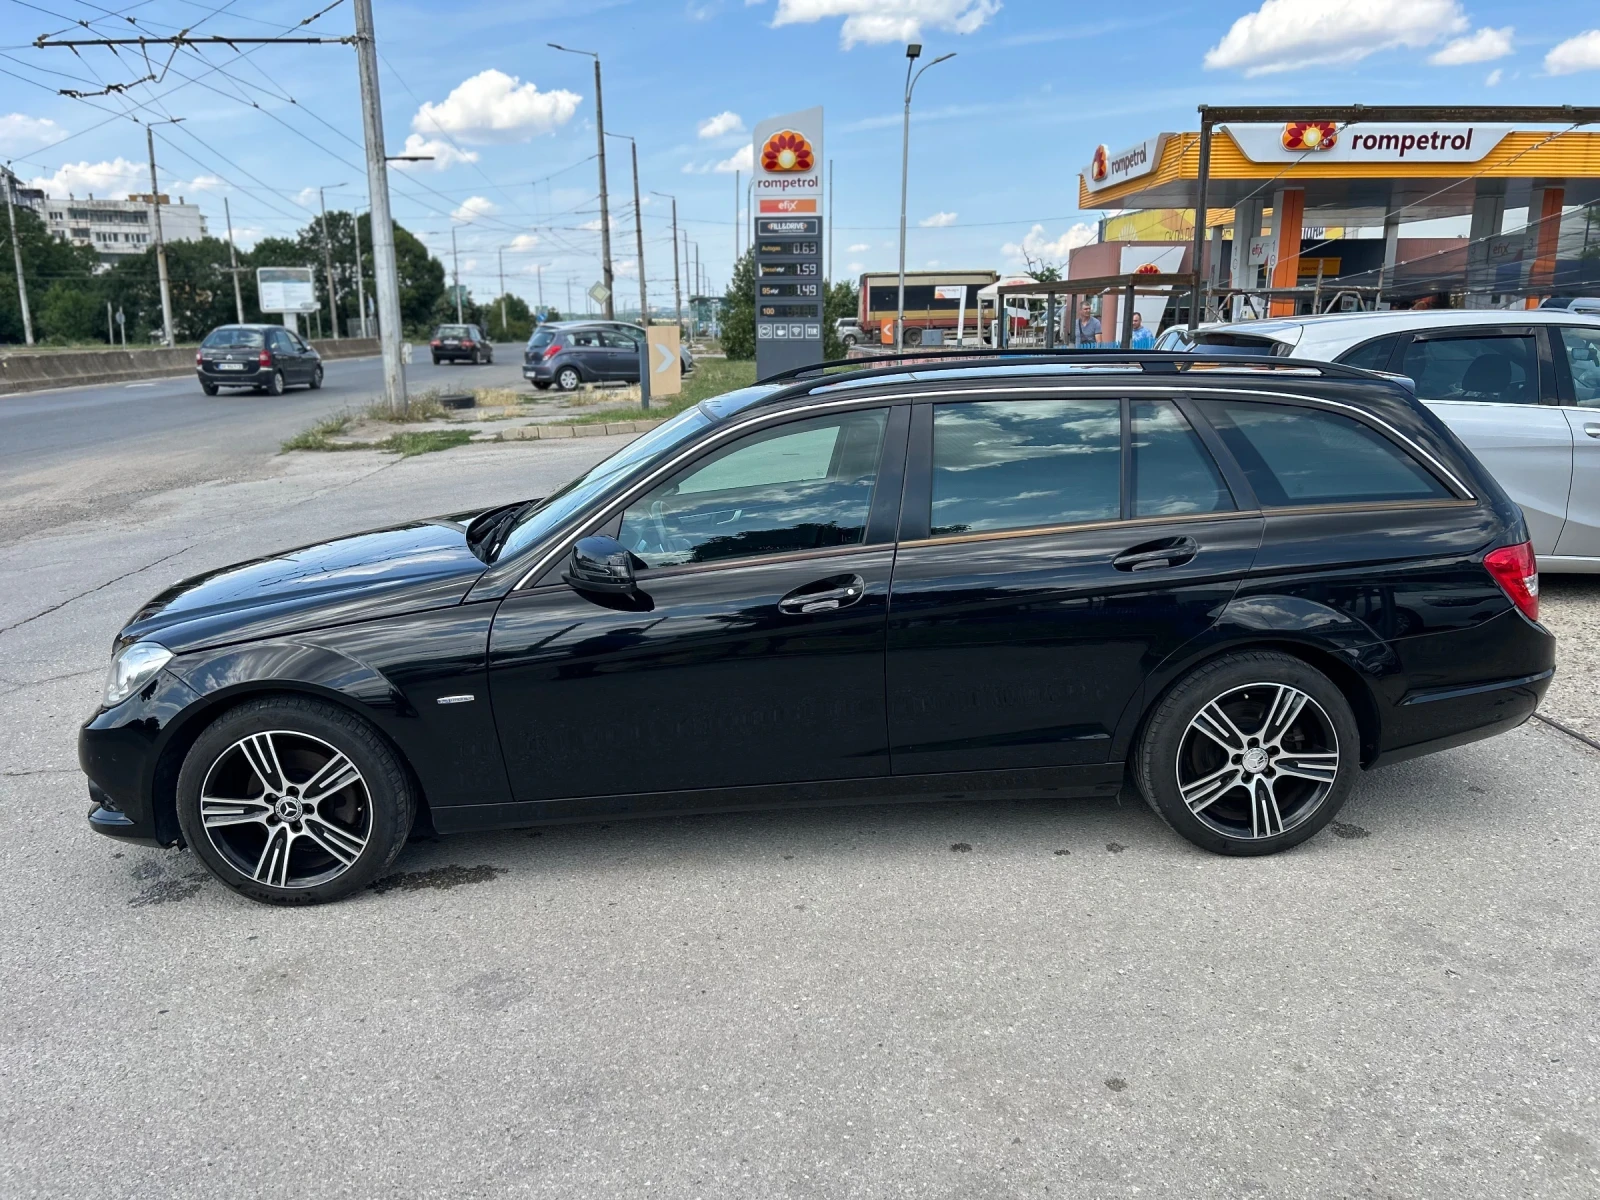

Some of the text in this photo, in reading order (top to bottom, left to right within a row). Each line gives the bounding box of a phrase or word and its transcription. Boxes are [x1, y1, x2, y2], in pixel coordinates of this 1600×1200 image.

[1352, 128, 1473, 157] rompetrol
[1112, 141, 1146, 176] rompetrol
[758, 176, 818, 191] rompetrol
[778, 201, 798, 211] efix
[770, 222, 804, 230] FILL&DRIVE
[793, 243, 817, 254] 0.63
[797, 264, 817, 275] 1.59
[762, 287, 771, 295] 95
[797, 285, 817, 296] 1.49
[763, 307, 775, 315] 100
